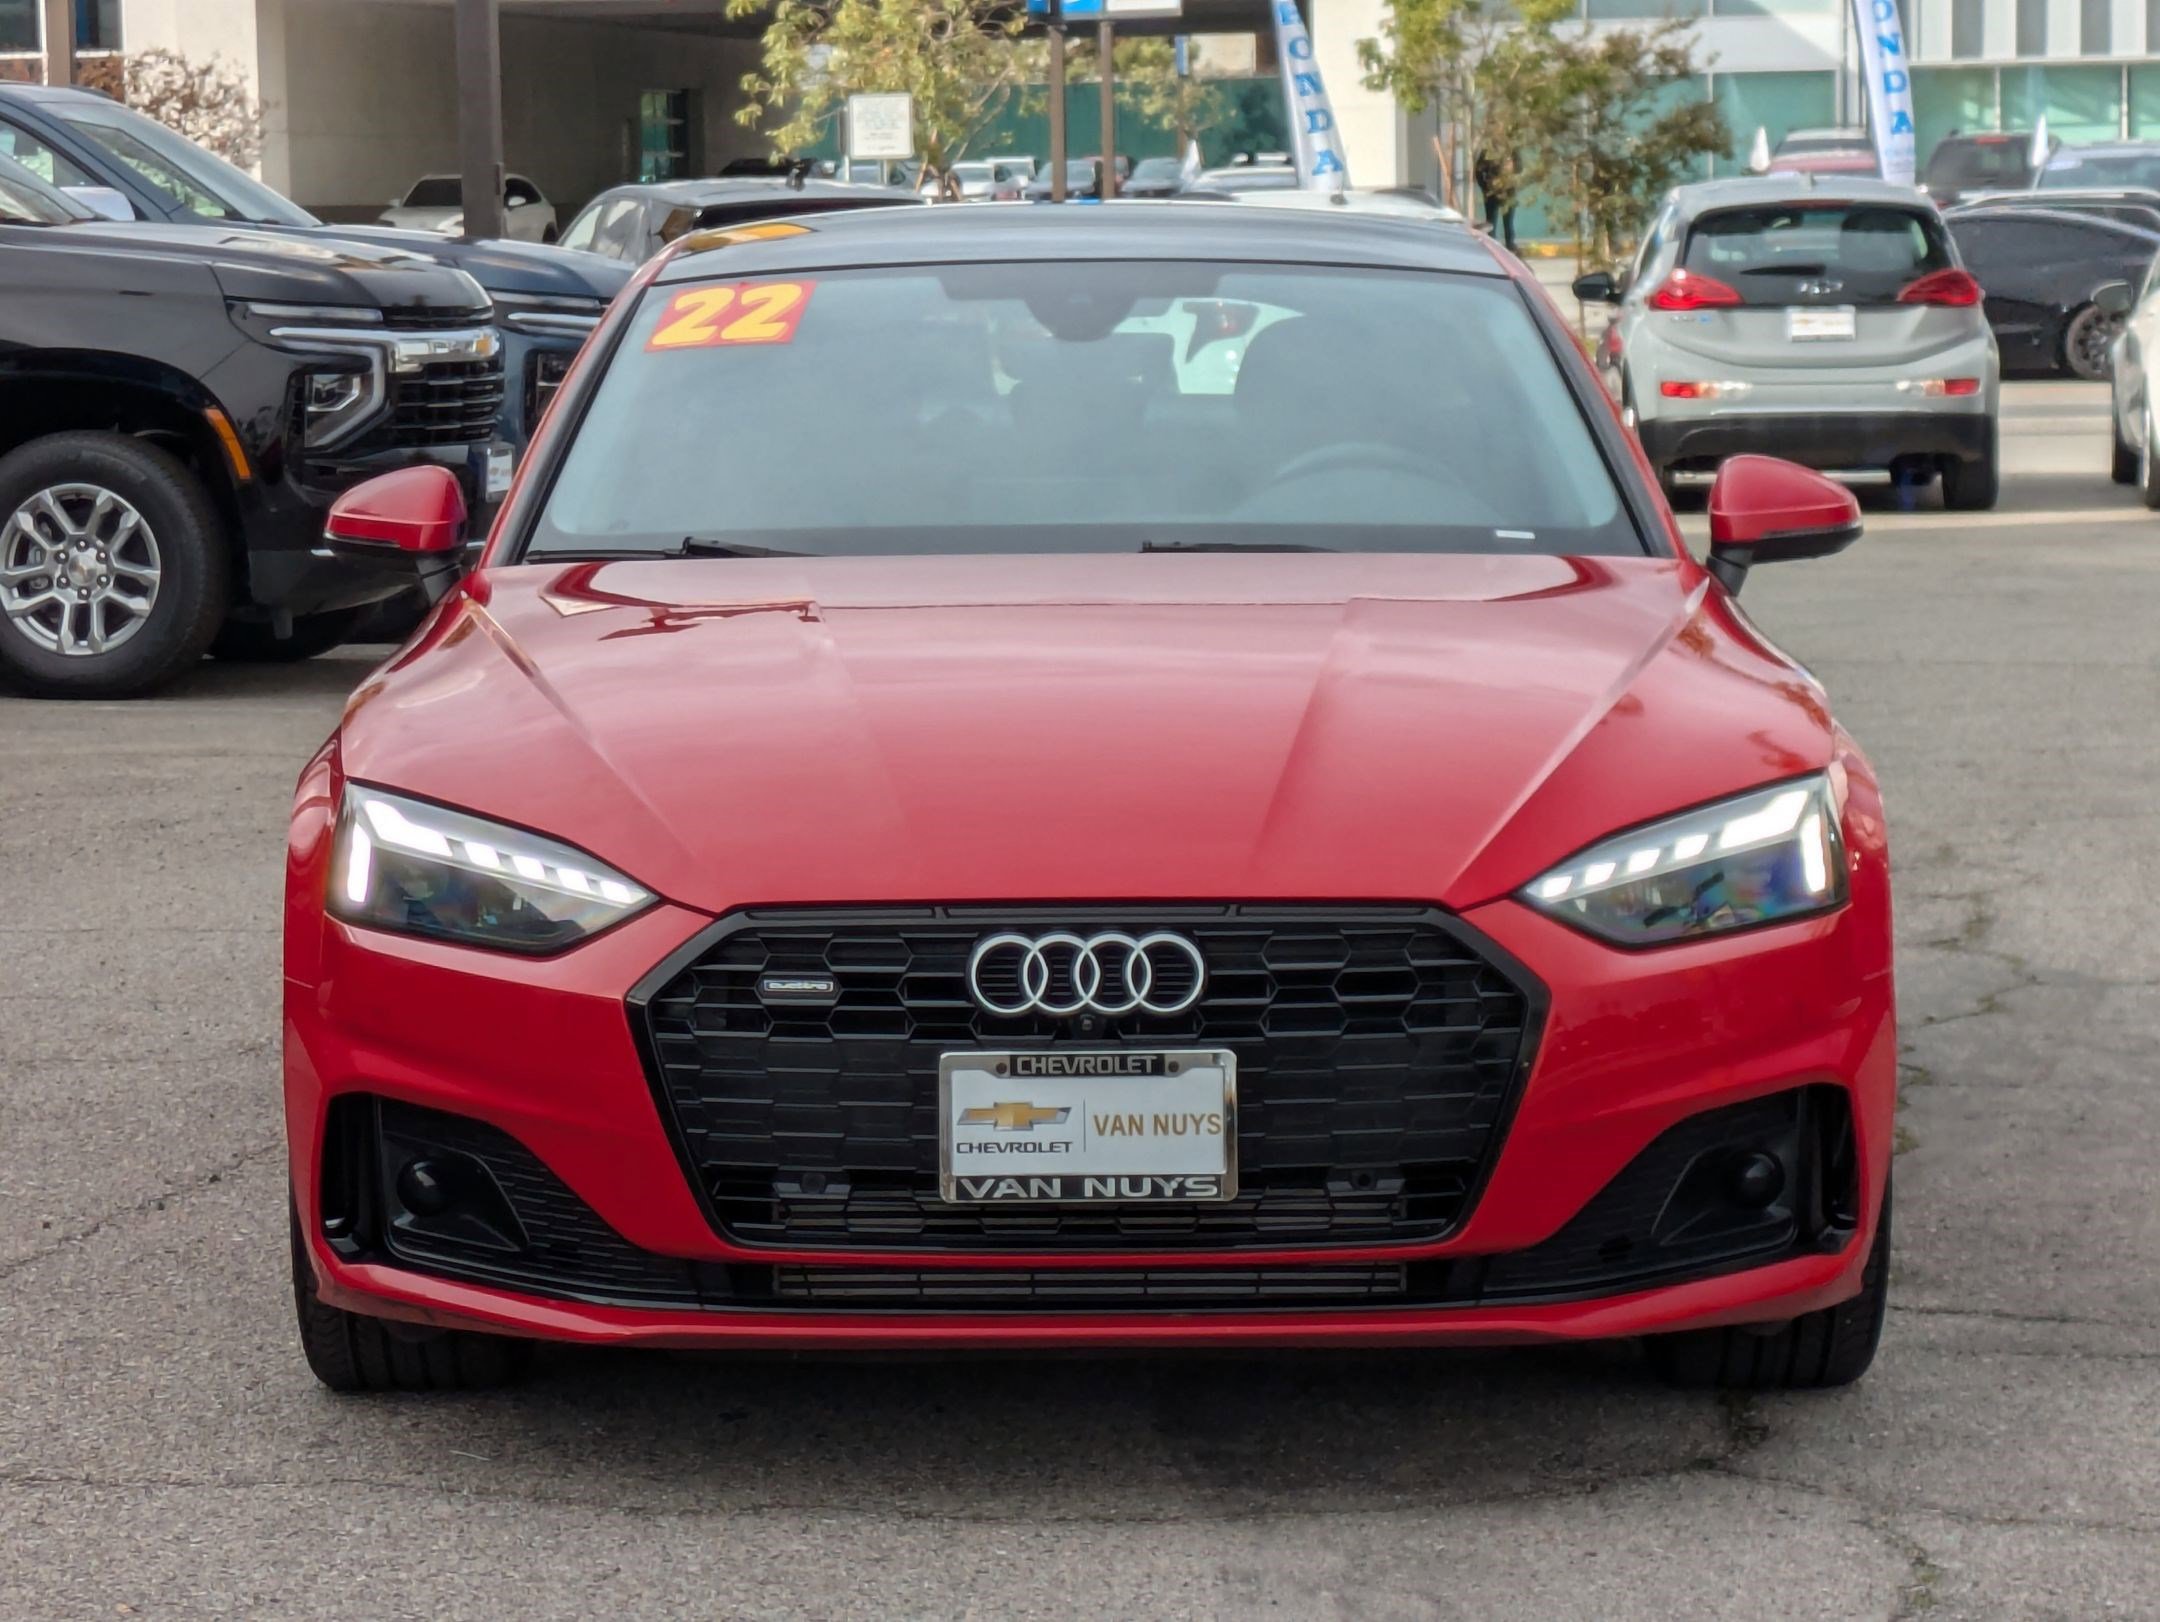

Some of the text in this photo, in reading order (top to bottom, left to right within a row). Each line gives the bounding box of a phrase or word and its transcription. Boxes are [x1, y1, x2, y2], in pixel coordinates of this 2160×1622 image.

[652, 283, 802, 345] 22
[1016, 1055, 1158, 1075] CHEVROLET
[1093, 1113, 1222, 1137] VAN NUYS
[956, 1141, 1073, 1154] CHEVROLET
[959, 1176, 1218, 1198] VAN NUYS
